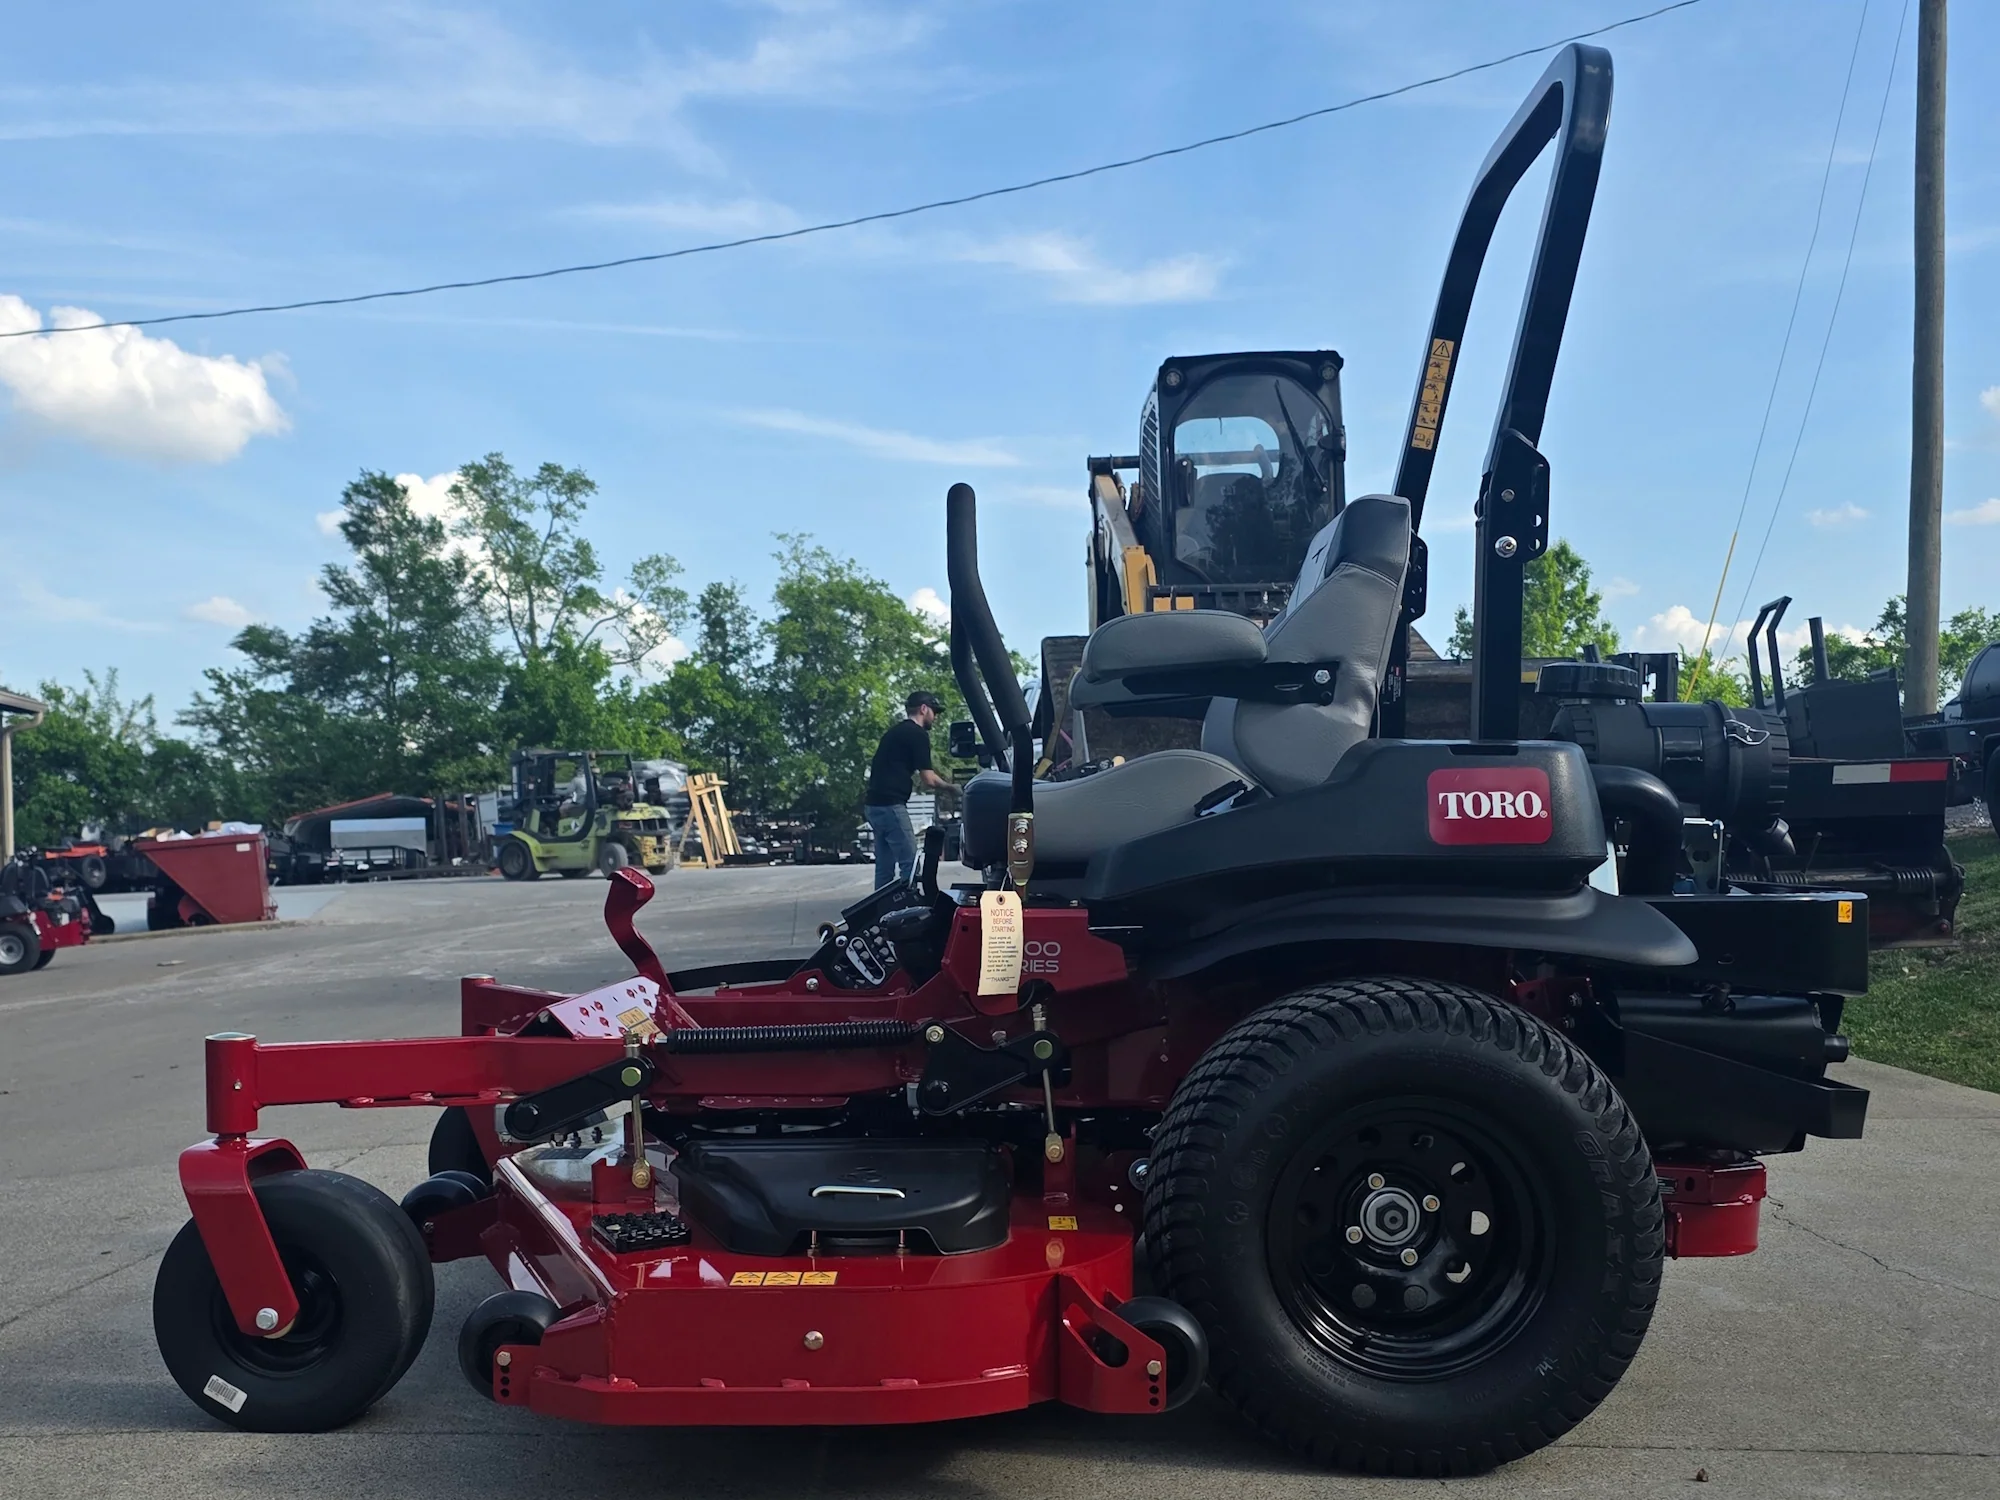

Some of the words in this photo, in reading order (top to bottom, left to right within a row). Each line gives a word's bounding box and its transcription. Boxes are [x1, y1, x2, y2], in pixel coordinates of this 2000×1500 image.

[1438, 790, 1542, 820] TORO
[1024, 940, 1061, 957] 00
[1021, 959, 1060, 973] RIES
